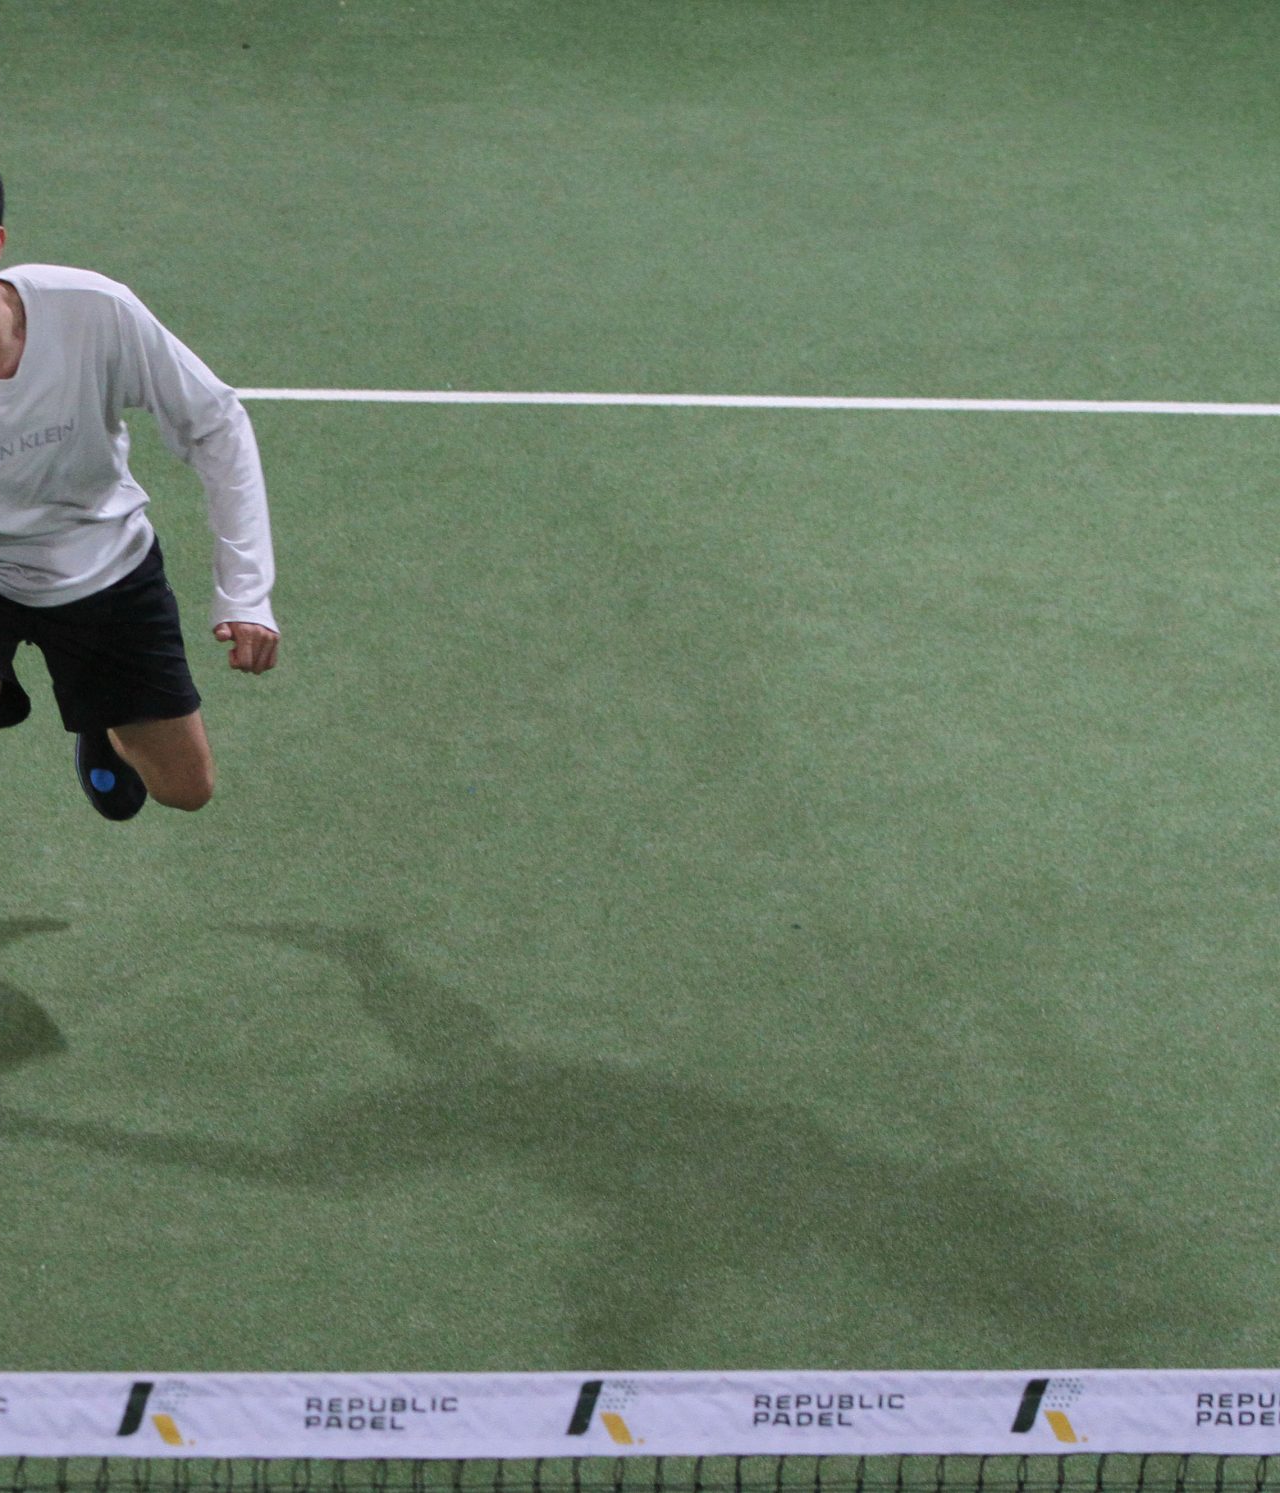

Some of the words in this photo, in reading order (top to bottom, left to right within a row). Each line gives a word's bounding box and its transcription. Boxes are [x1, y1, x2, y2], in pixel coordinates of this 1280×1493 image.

[20, 418, 74, 451] KLEIN
[305, 1397, 458, 1413] REPUBLIC
[754, 1394, 906, 1411] REPUBLIC
[1197, 1393, 1280, 1409] REPU
[304, 1415, 404, 1430] PADEL
[753, 1412, 854, 1428] PADEL
[1196, 1411, 1280, 1427] PADE
